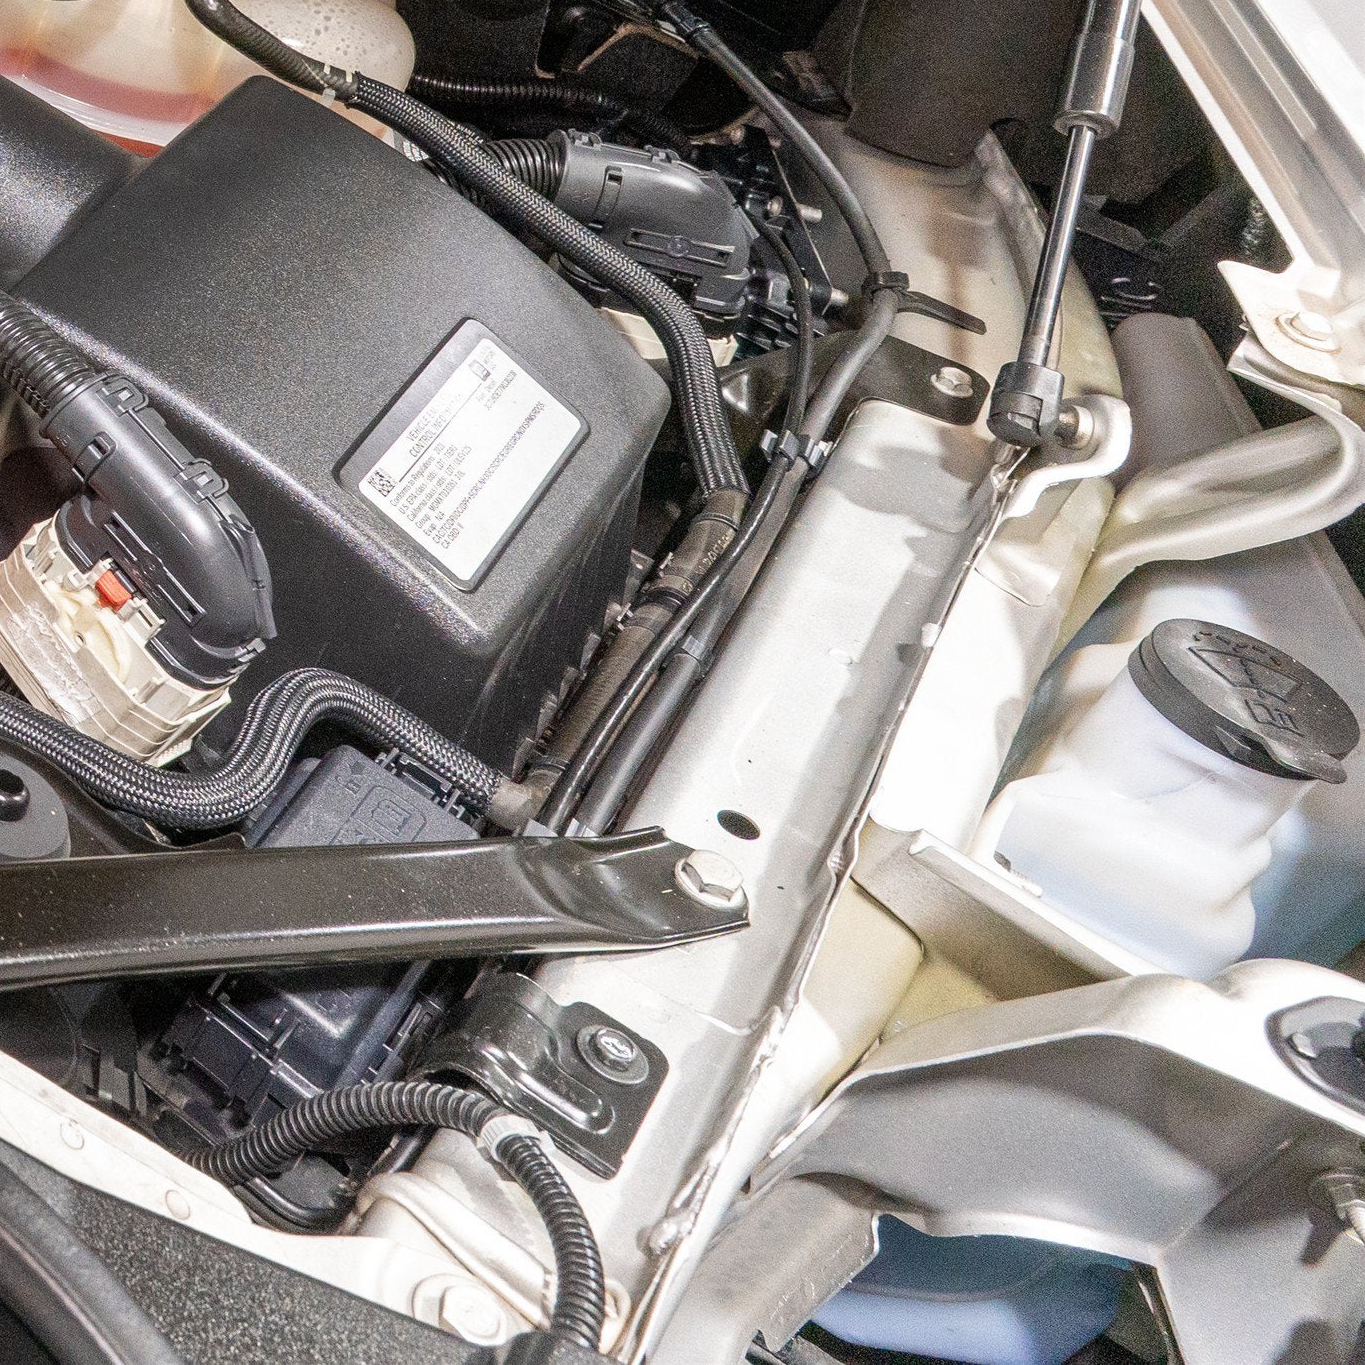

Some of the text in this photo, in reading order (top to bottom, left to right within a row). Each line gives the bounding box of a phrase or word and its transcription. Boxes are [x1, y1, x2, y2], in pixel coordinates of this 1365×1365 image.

[405, 414, 431, 442] VEHICLE
[408, 426, 437, 458] CONTROL
[388, 481, 412, 507] Conforms
